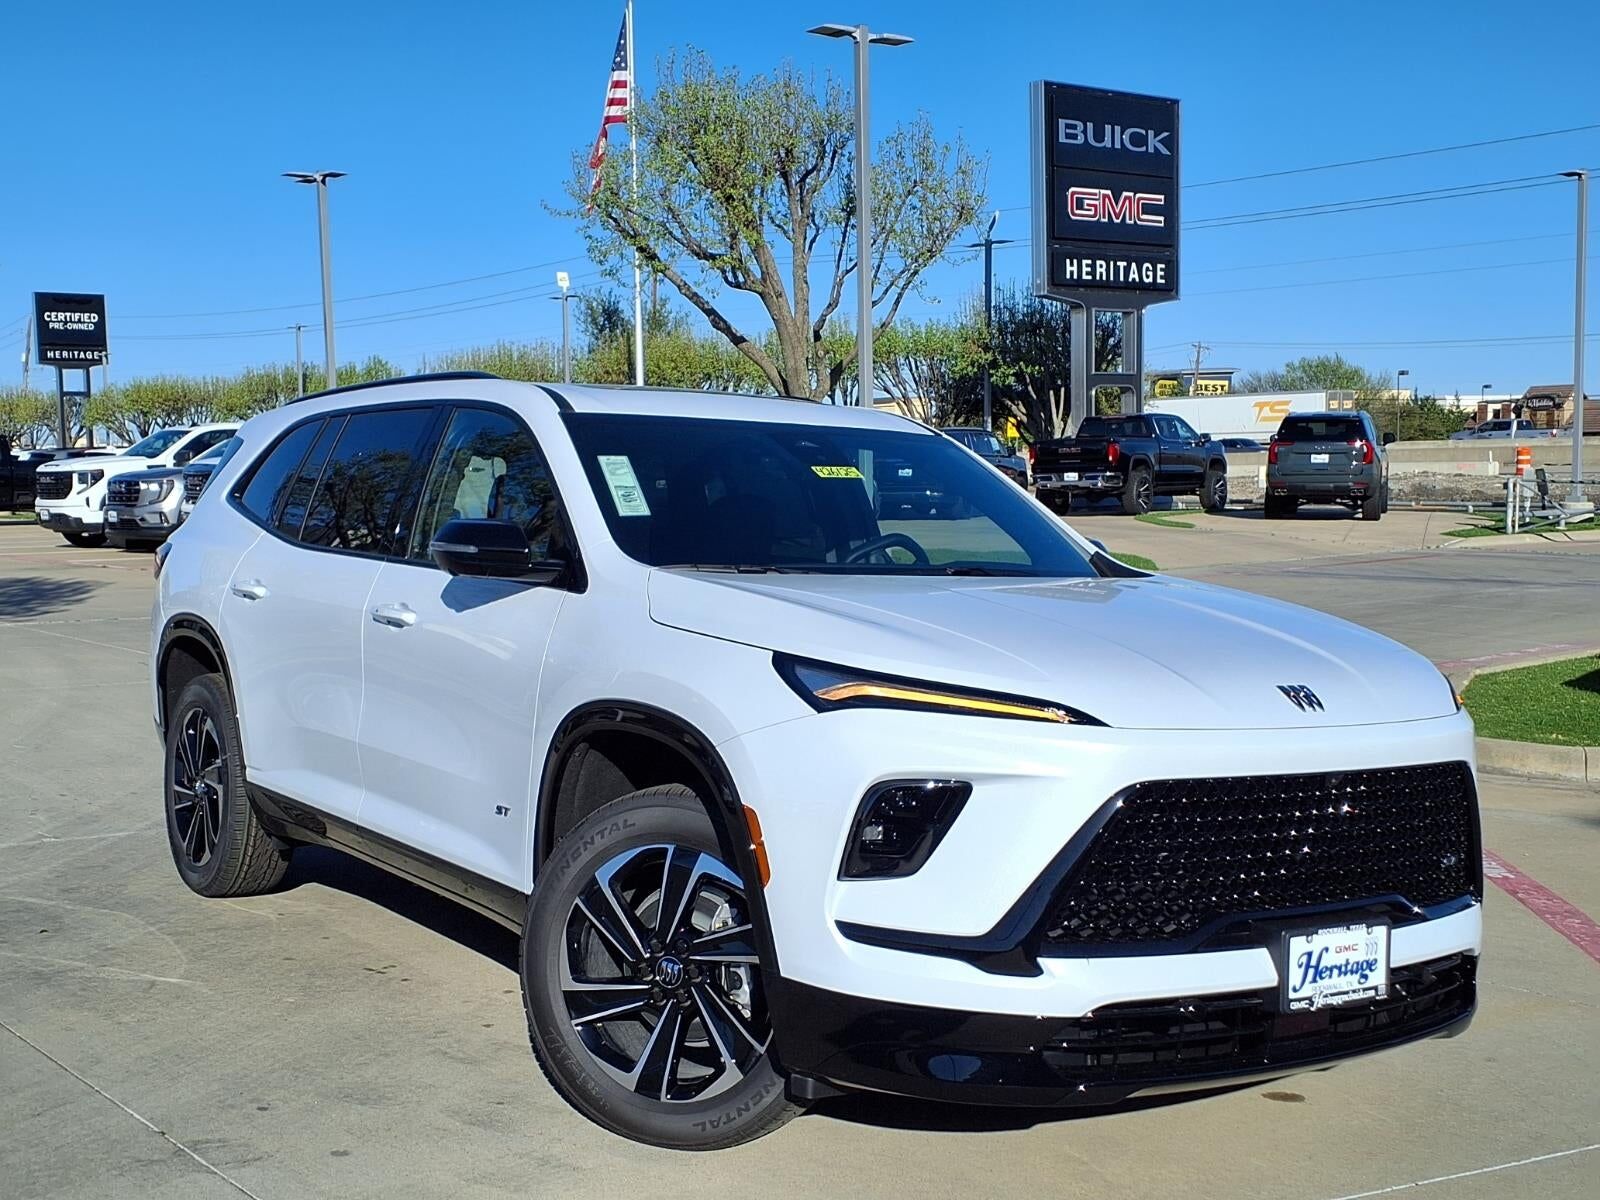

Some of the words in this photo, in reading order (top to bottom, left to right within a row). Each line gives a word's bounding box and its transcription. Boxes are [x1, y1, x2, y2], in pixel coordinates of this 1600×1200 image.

[1058, 118, 1171, 156] BUICK
[1067, 187, 1165, 227] GMC
[1066, 258, 1166, 284] HERITAGE
[44, 311, 99, 323] CERTIFIED
[49, 322, 95, 331] PRE-OWNED
[47, 350, 100, 360] HERITAGE
[1197, 383, 1227, 393] BEST
[1252, 400, 1293, 424] TS
[495, 804, 511, 817] ST
[1335, 943, 1359, 954] GMC
[1291, 946, 1378, 993] Heritage
